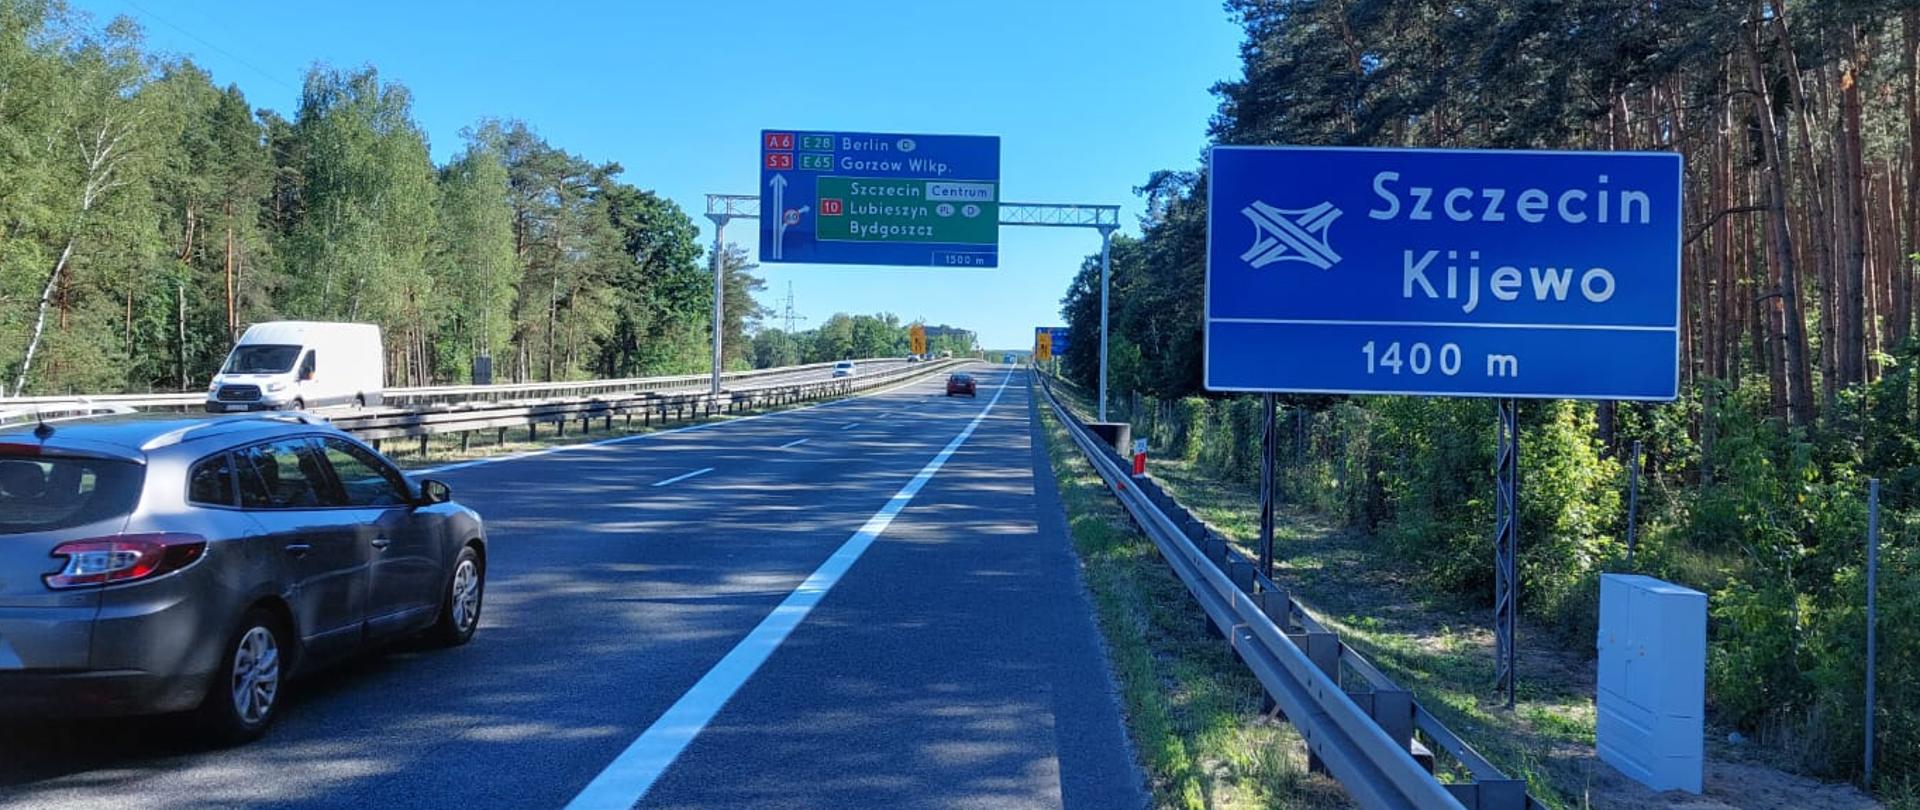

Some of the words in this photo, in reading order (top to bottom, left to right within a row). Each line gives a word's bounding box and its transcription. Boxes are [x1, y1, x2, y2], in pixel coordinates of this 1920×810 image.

[842, 137, 889, 152] Berlin
[908, 158, 952, 176] Wlkp.
[851, 182, 920, 197] Szczecin
[932, 184, 987, 198] Centrum
[1369, 171, 1651, 224] Szczecin
[824, 201, 839, 213] 10
[850, 200, 928, 219] Lubieszyn
[850, 220, 933, 238] Bydgoszcz
[945, 254, 971, 265] 1500
[975, 257, 984, 265] m
[1402, 249, 1616, 315] Kijewo
[1362, 340, 1463, 376] 1400
[1486, 352, 1519, 377] m
